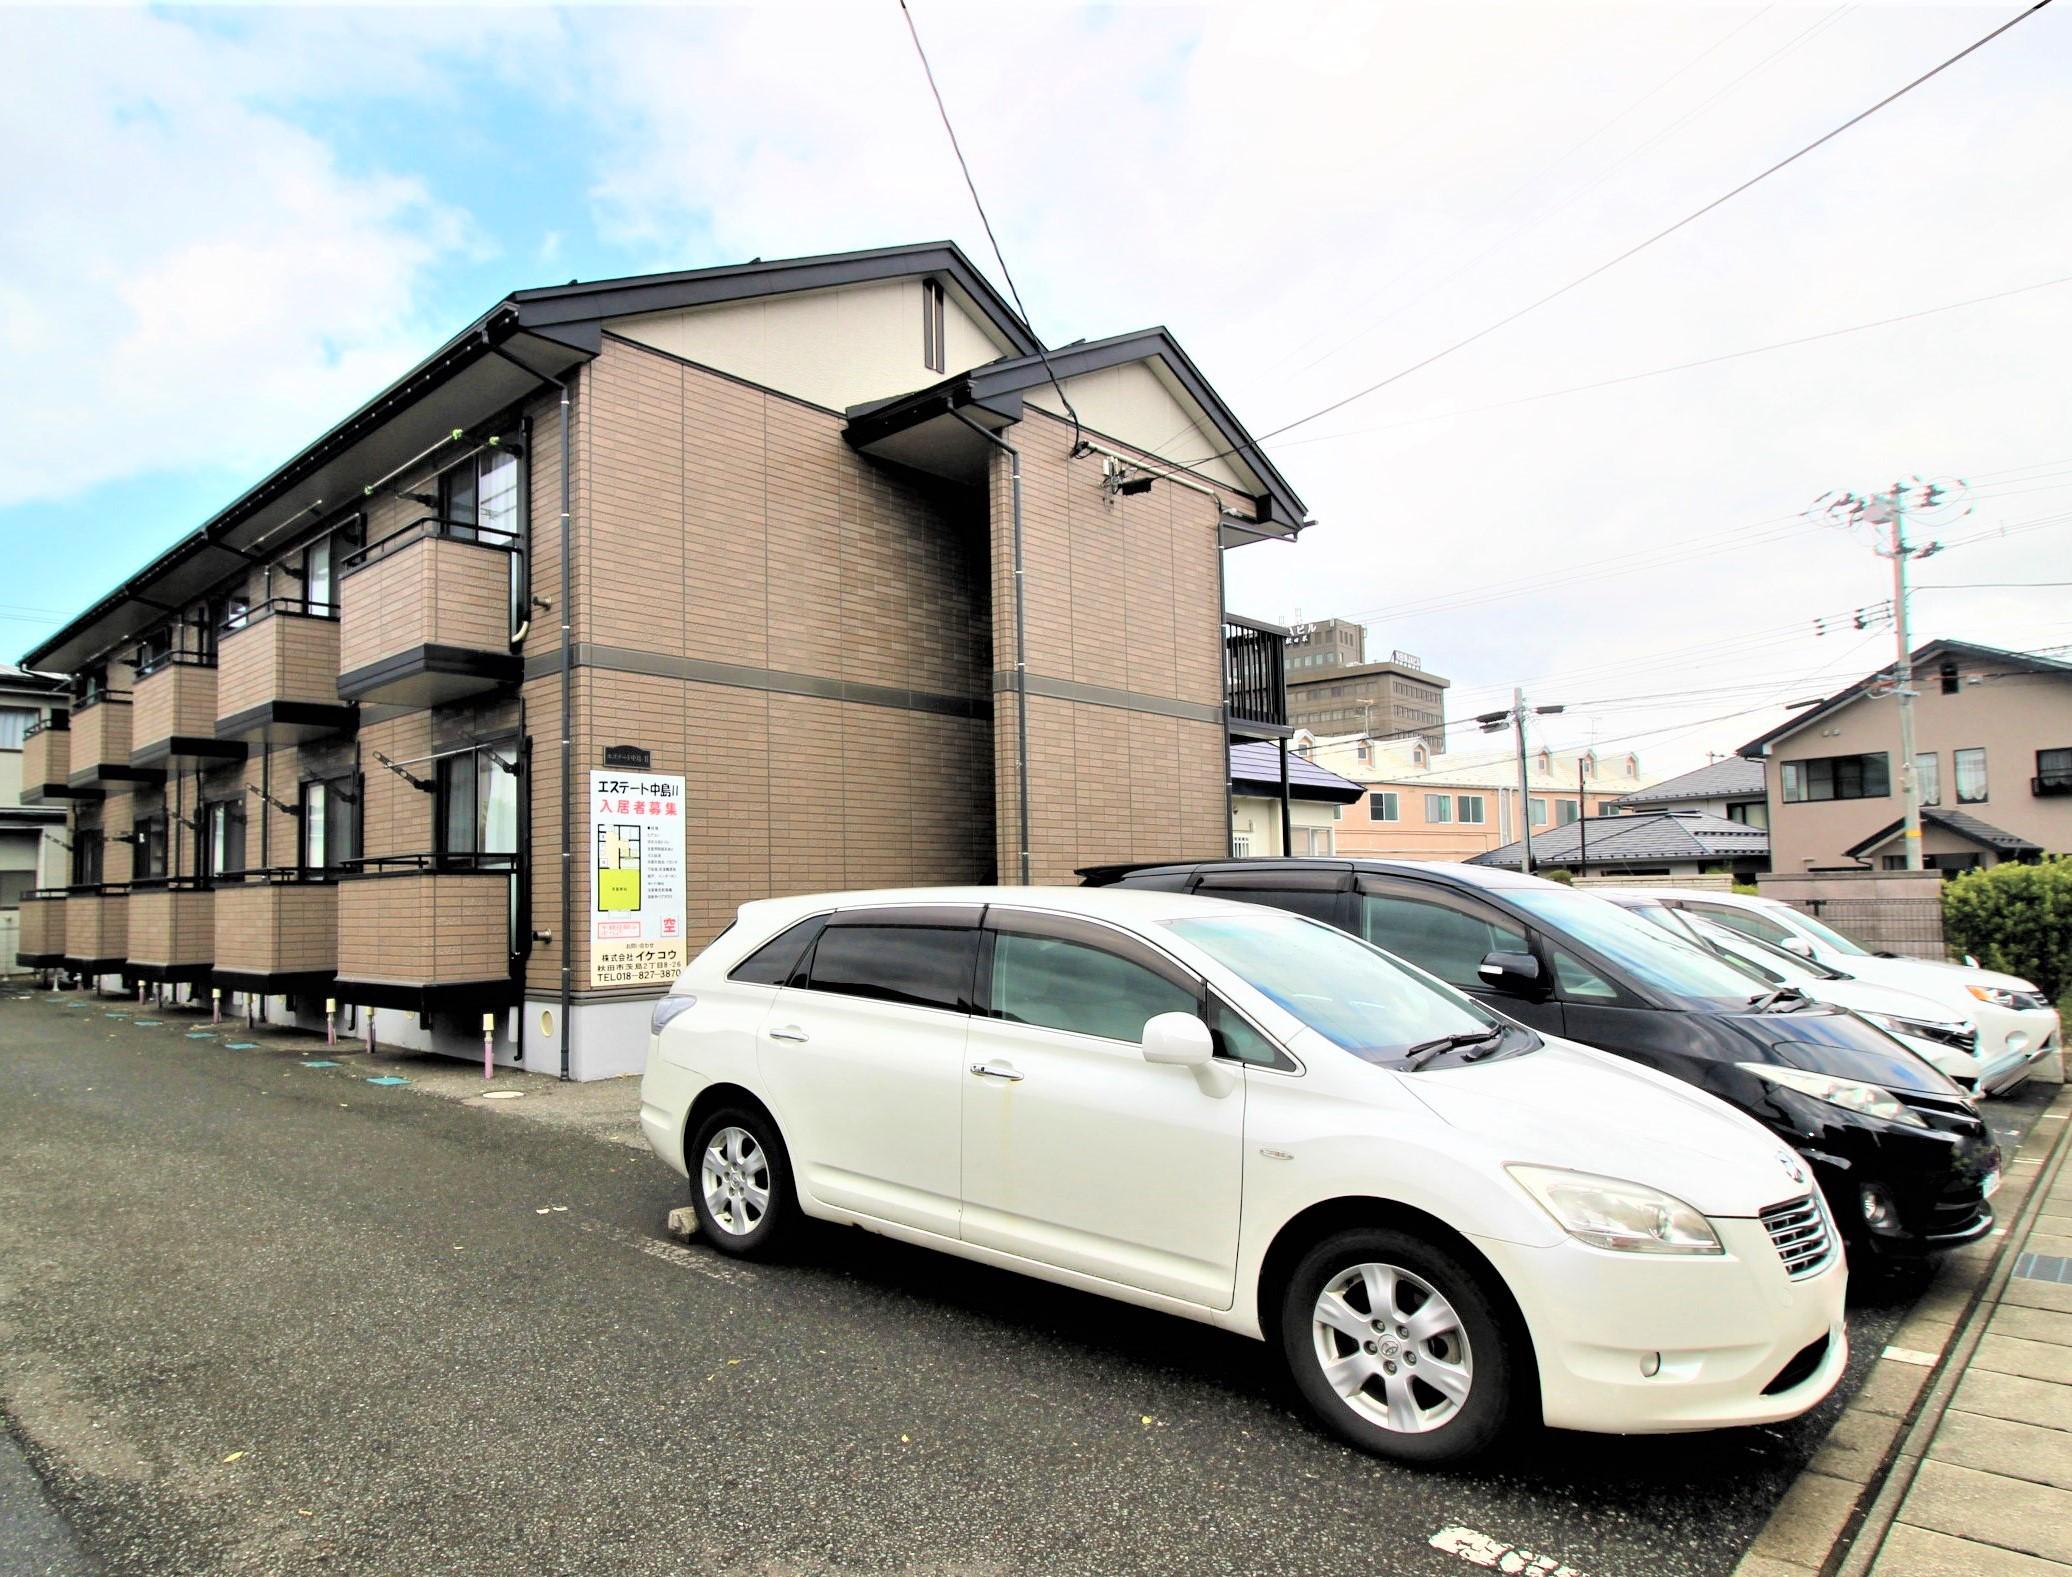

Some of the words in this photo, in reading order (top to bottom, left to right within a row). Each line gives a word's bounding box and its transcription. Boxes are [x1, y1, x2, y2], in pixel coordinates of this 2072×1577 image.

[600, 799, 678, 815] 入居者募集
[663, 917, 676, 933] 空
